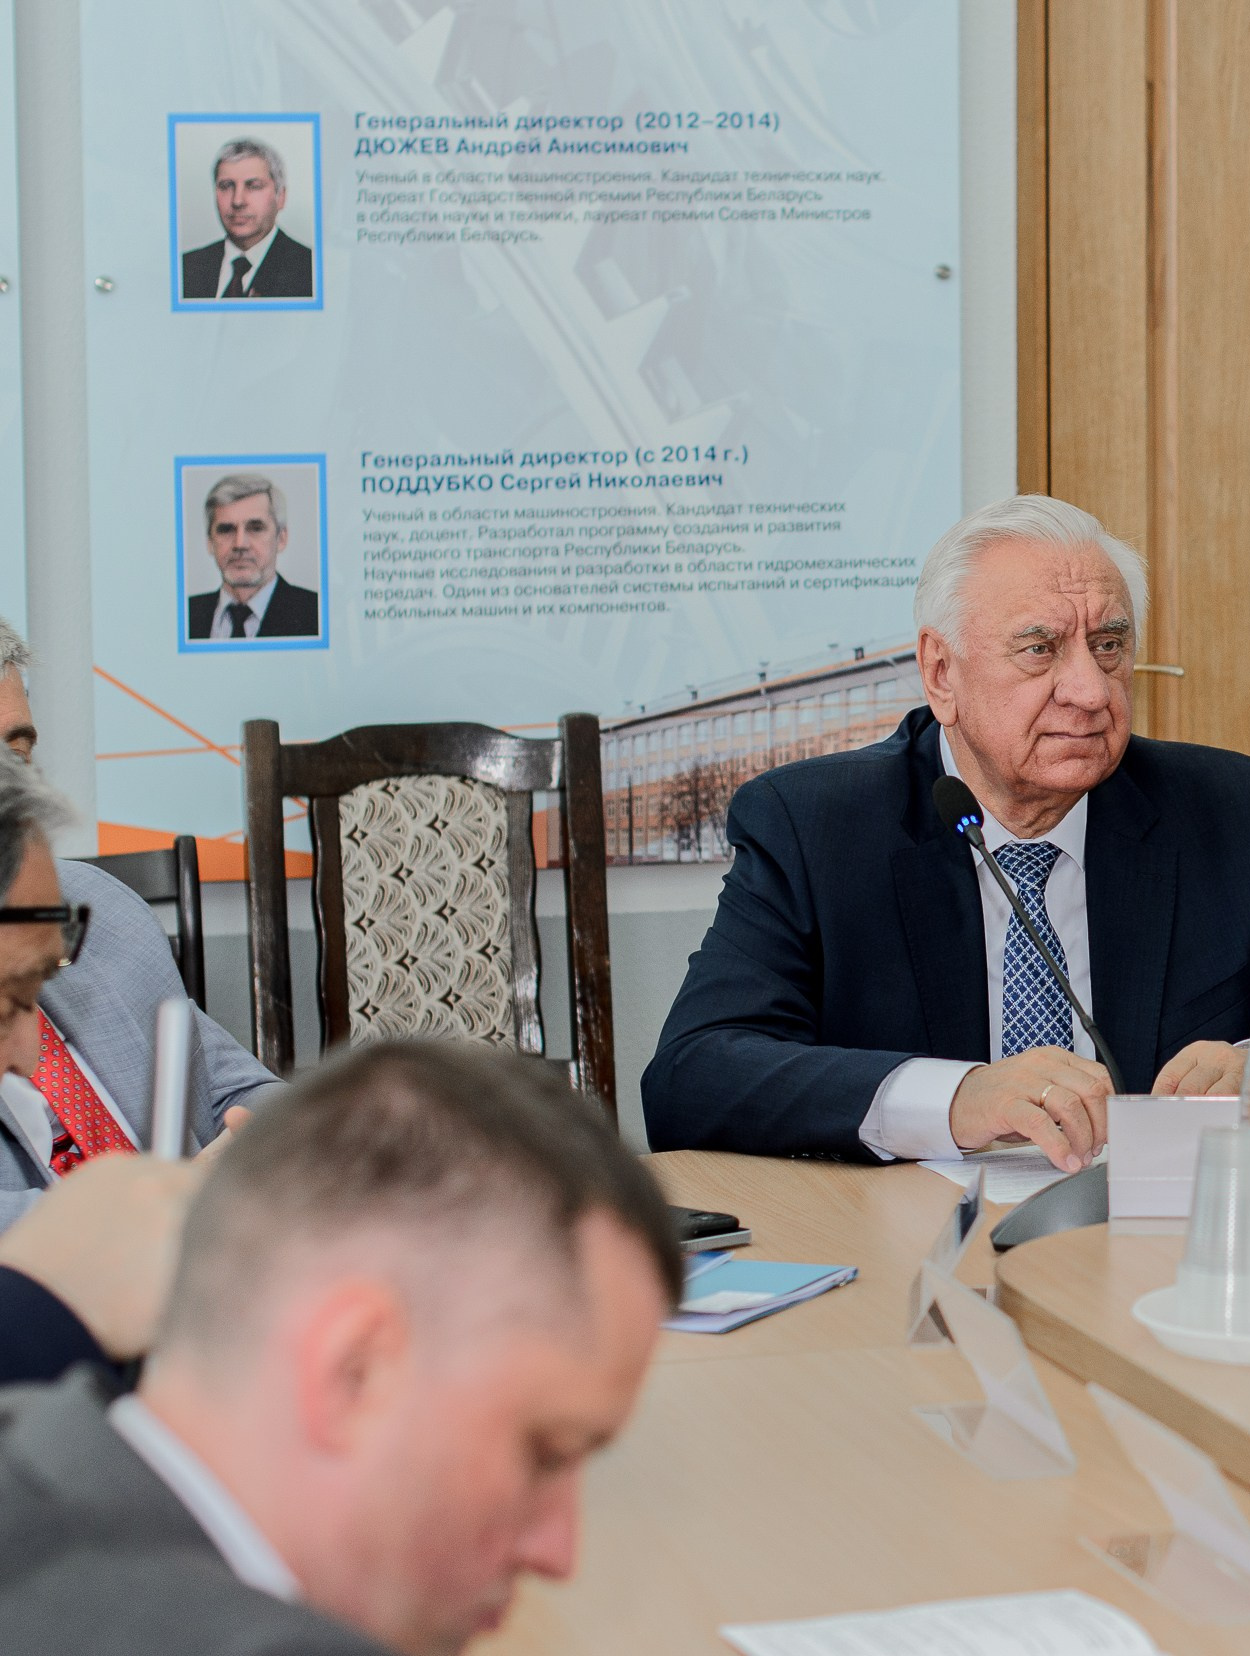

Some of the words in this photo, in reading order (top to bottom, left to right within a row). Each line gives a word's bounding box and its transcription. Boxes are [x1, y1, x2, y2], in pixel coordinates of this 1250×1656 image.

[354, 112, 509, 132] Генеральный
[516, 114, 624, 132] директор
[635, 111, 782, 131] (2012–2014)
[354, 137, 449, 157] ДЮЖЕВ
[456, 137, 541, 157] Андрей
[548, 137, 690, 153] Анисимович
[355, 169, 418, 184] Ученый
[422, 172, 432, 184] в
[436, 169, 504, 184] области
[508, 171, 653, 186] машиностроения.
[661, 168, 738, 185] Кандидат
[744, 171, 843, 182] технических
[846, 171, 887, 184] наук.
[356, 188, 424, 206] Лауреат
[429, 188, 576, 206] Государственной
[578, 190, 642, 205] премии
[646, 187, 743, 204] Республики
[746, 187, 824, 203] Беларусь
[356, 210, 366, 223] в
[370, 207, 439, 223] области
[443, 210, 490, 225] науки
[494, 210, 505, 222] и
[509, 210, 577, 225] техники,
[583, 209, 648, 225] лауреат
[652, 209, 715, 224] премии
[718, 206, 777, 221] Совета
[780, 206, 873, 224] Министров
[356, 226, 456, 245] Республики
[460, 226, 545, 244] Беларусь.
[361, 448, 514, 471] Генеральный
[521, 449, 628, 469] директор
[634, 446, 655, 467] (с
[662, 445, 717, 463] 2014
[723, 444, 750, 465] г.)
[361, 473, 494, 495] ПОДДУБКО
[500, 472, 581, 493] Сергей
[588, 469, 725, 488] Николаевич
[362, 507, 425, 522] Ученый
[429, 510, 438, 521] в
[442, 506, 510, 521] области
[514, 507, 660, 522] машиностроения.
[665, 503, 743, 519] Кандидат
[748, 504, 847, 515] технических
[362, 529, 404, 544] наук,
[410, 528, 473, 543] доцент.
[478, 523, 574, 542] Разработал
[579, 524, 669, 539] программу
[673, 523, 750, 538] создания
[754, 523, 763, 533] и
[767, 521, 843, 536] развития
[363, 545, 461, 564] гибридного
[466, 546, 560, 562] транспорта
[564, 541, 661, 559] Республики
[665, 539, 747, 557] Беларусь.
[363, 565, 435, 583] Научные
[440, 565, 557, 581] исследования
[561, 565, 571, 575] и
[575, 560, 670, 578] разработки
[674, 563, 683, 573] в
[687, 558, 753, 572] области
[757, 558, 917, 574] гидромеханических
[363, 586, 435, 602] передач.
[443, 582, 487, 600] Один
[490, 585, 510, 596] из
[514, 579, 619, 595] основателей
[623, 581, 694, 593] системы
[698, 576, 786, 591] испытаний
[790, 579, 800, 589] и
[803, 573, 919, 592] сертификации
[363, 602, 457, 619] мобильных
[461, 604, 519, 616] машин
[522, 604, 533, 615] и
[537, 603, 555, 614] их
[559, 601, 673, 614] компонентов.
